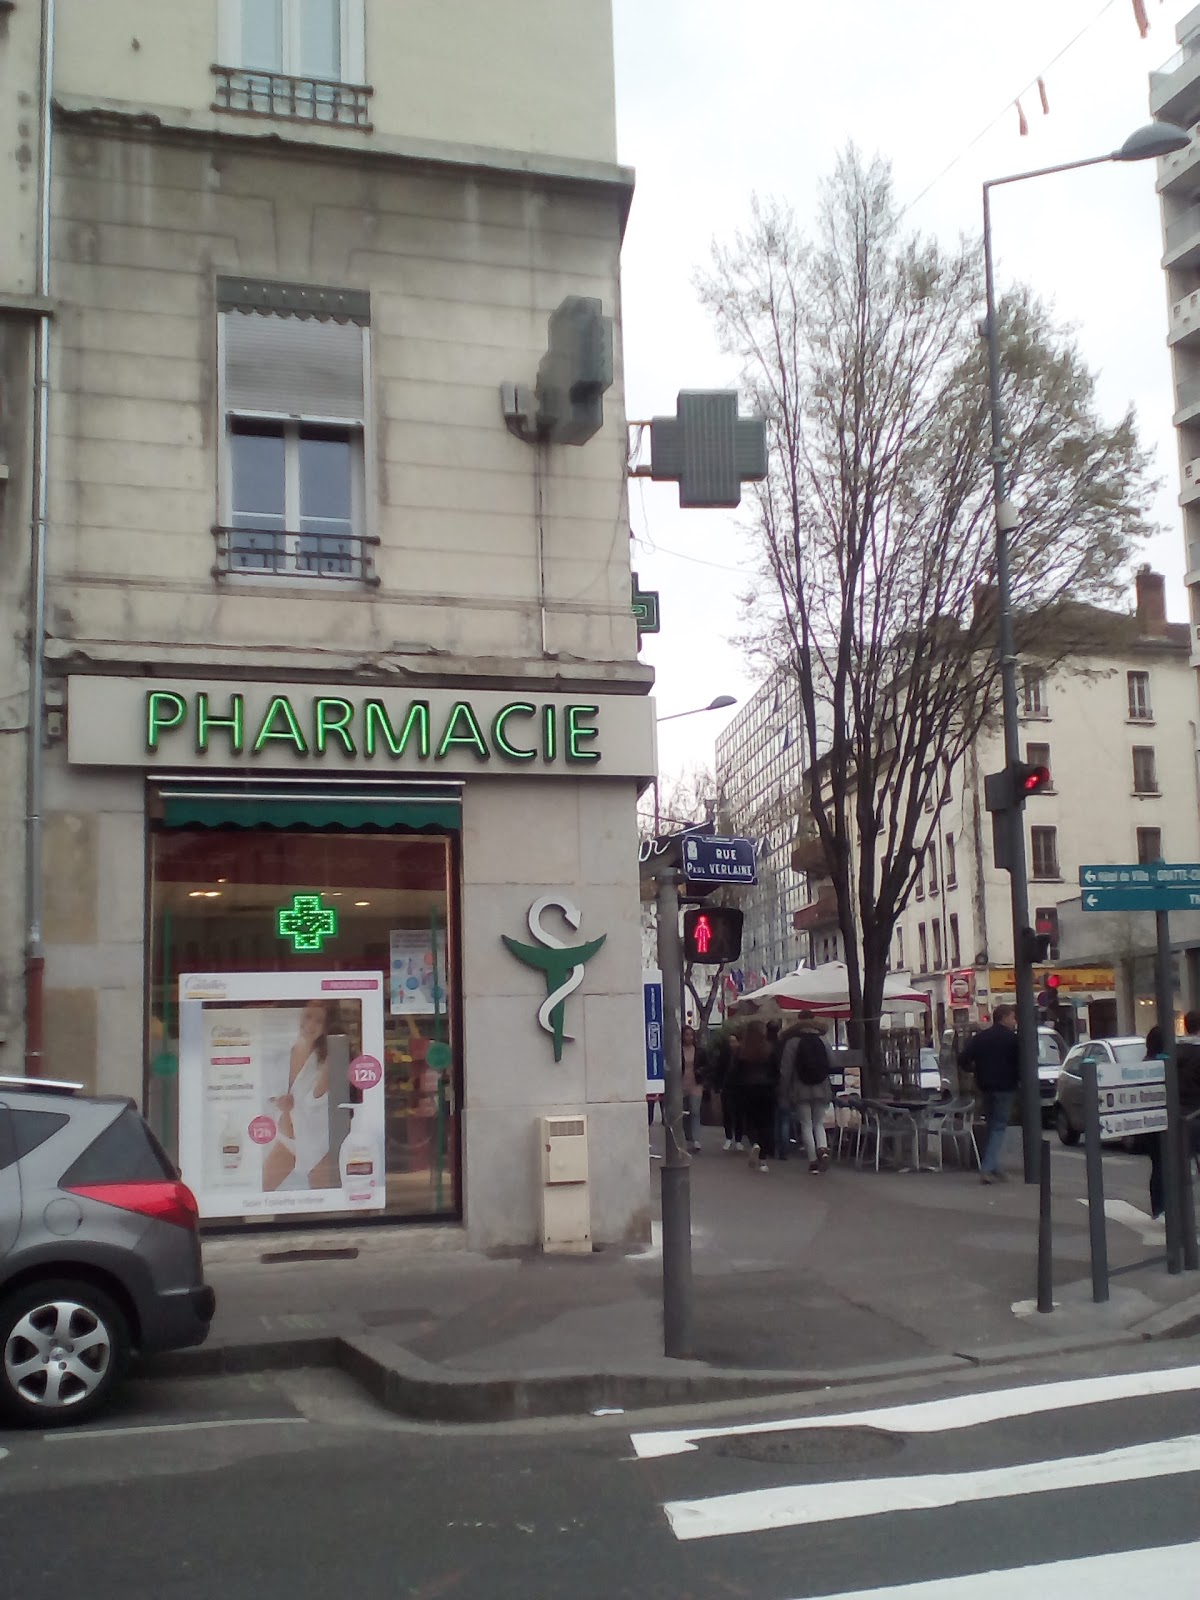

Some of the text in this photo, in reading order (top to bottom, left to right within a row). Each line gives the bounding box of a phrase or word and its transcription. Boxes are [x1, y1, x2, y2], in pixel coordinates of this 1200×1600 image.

[146, 690, 601, 762] PHARMACIE
[715, 848, 737, 860] RUE
[709, 864, 752, 876] VERLAINE
[354, 1070, 376, 1082] 12h
[253, 1127, 272, 1138] 12h
